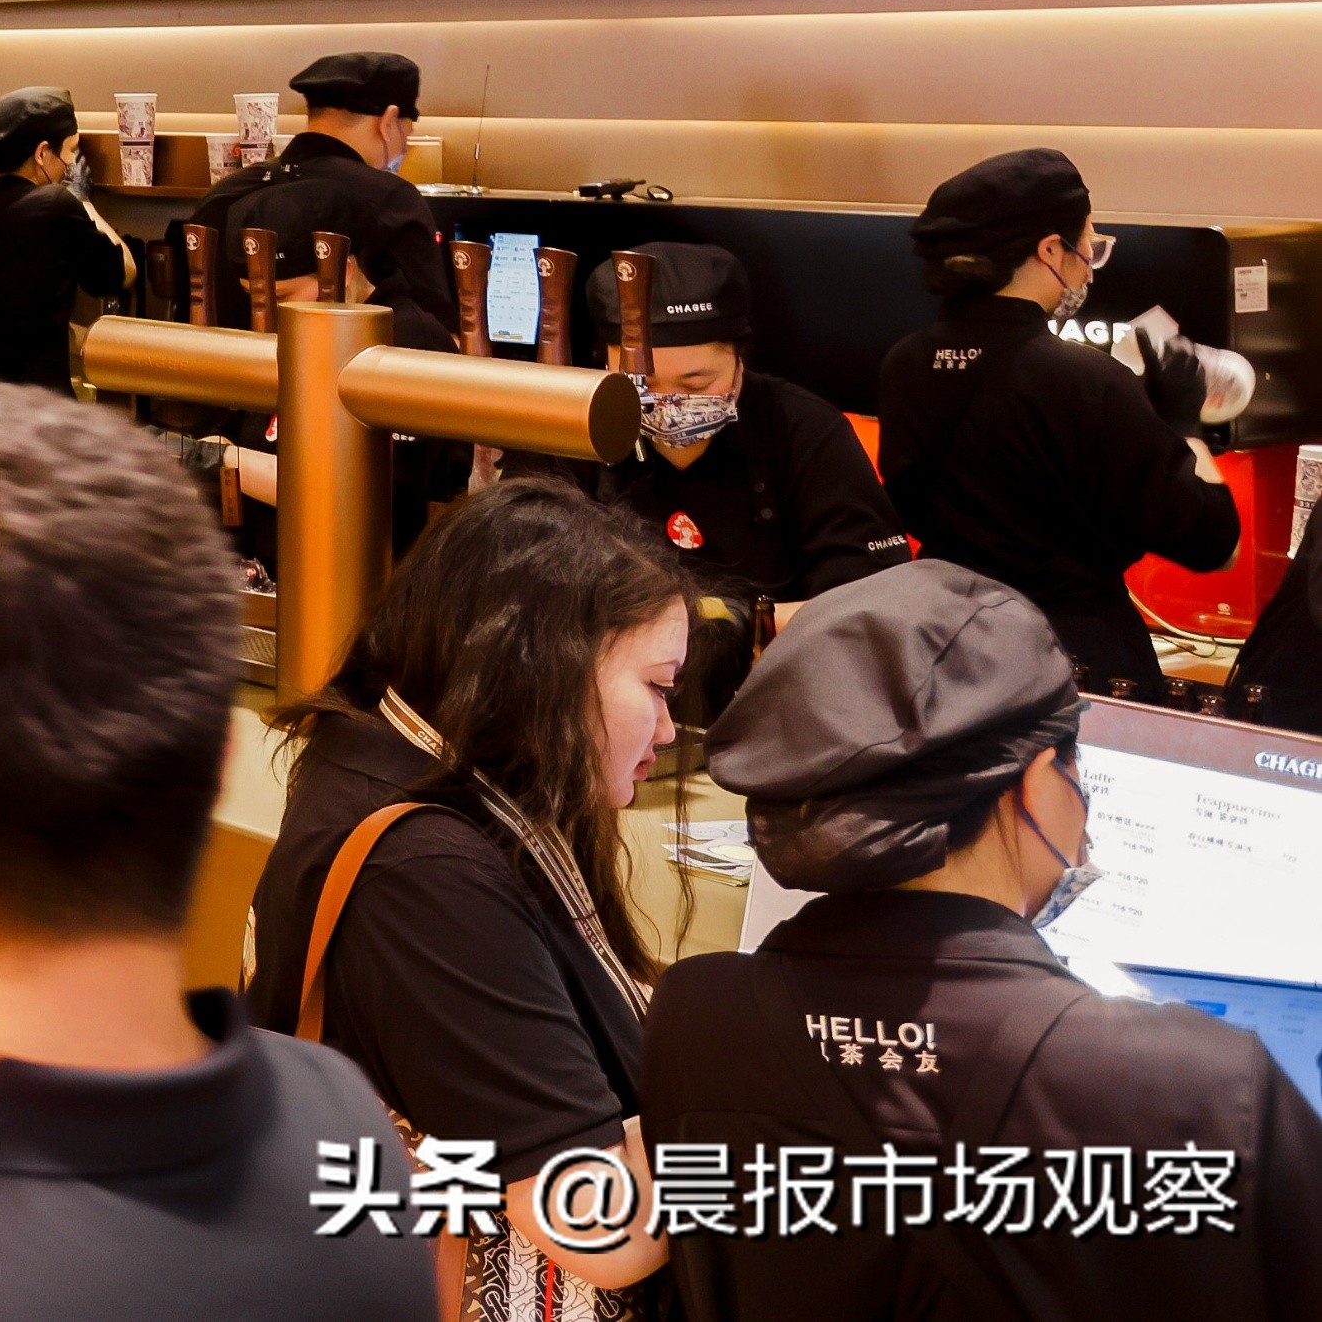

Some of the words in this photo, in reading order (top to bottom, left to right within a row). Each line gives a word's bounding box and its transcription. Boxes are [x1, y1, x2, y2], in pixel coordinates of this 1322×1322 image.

[666, 302, 714, 314] CHAGEE
[868, 535, 907, 551] CHAGEE
[805, 1014, 937, 1051] HELLO!
